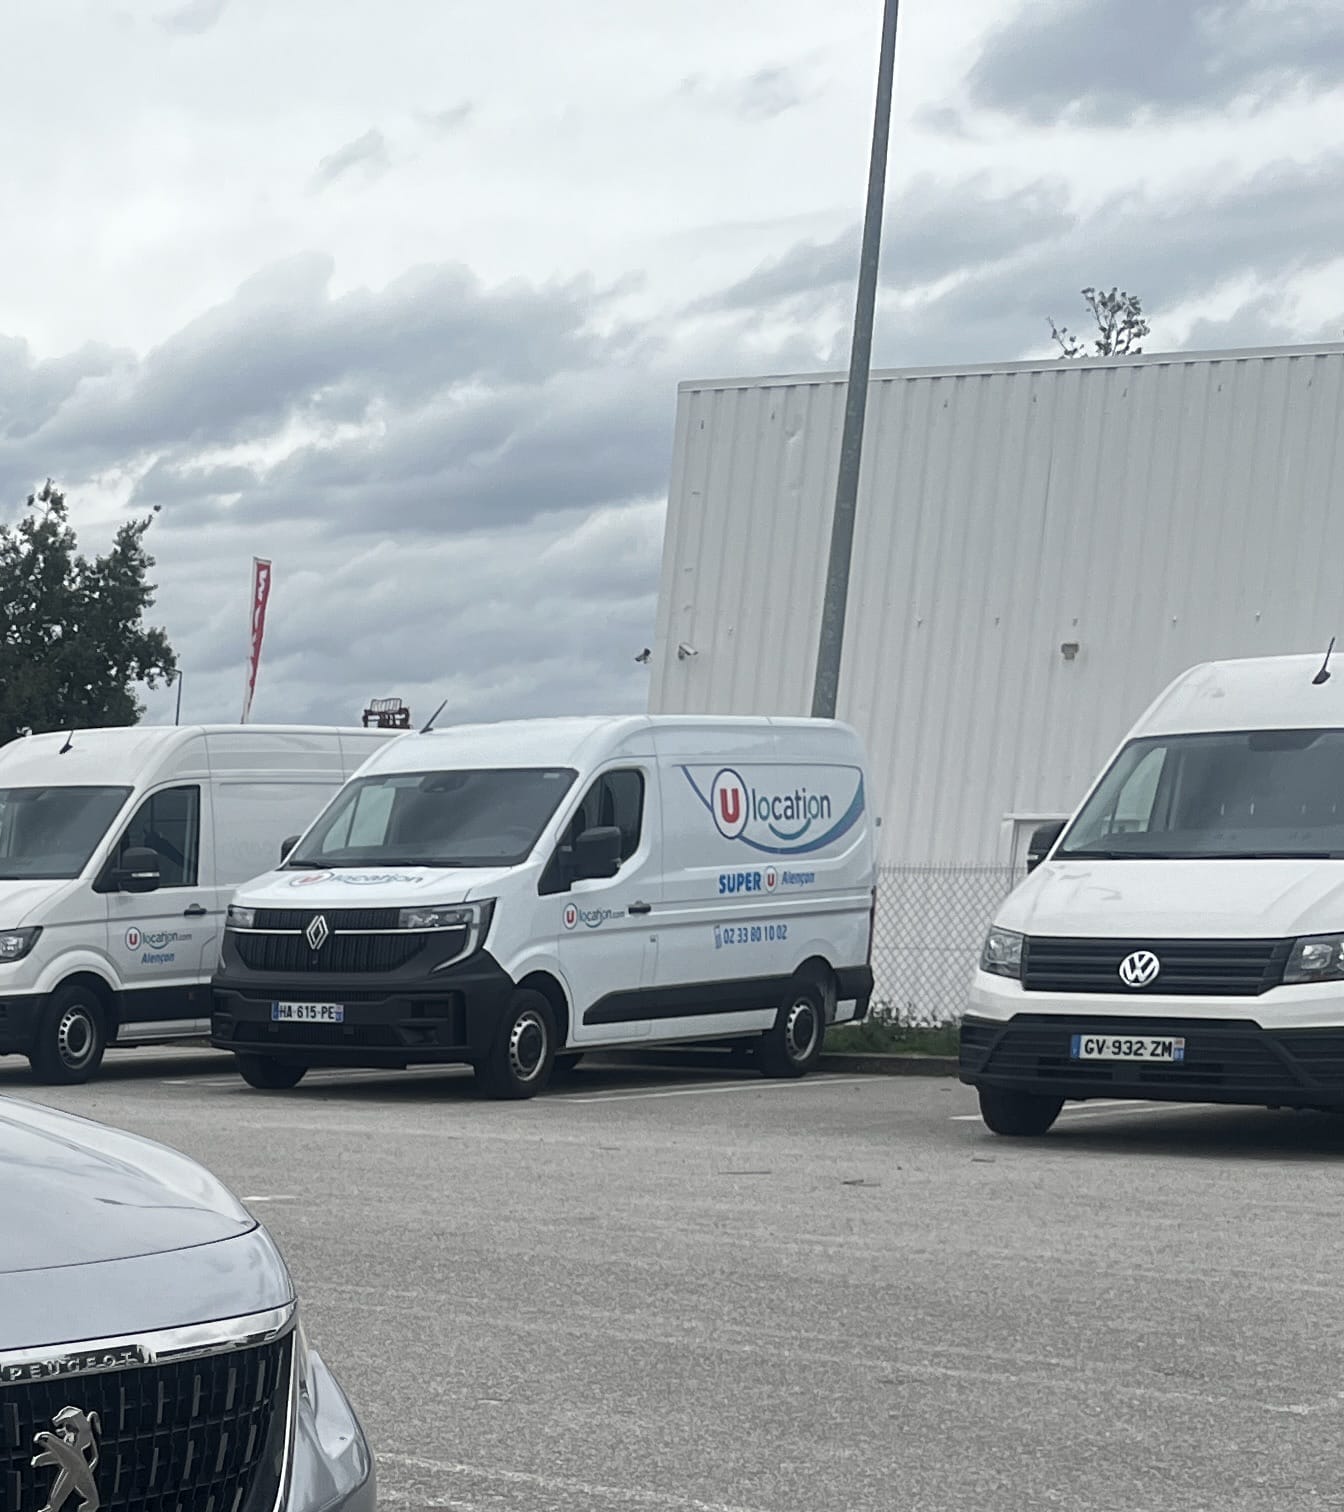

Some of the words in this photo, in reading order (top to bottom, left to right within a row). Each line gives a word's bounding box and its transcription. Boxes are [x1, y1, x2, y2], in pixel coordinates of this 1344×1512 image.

[720, 788, 740, 823] U
[752, 787, 832, 821] location
[719, 872, 761, 894] SUPER
[767, 873, 775, 887] U
[566, 910, 575, 924] U
[129, 933, 138, 945] U
[723, 928, 735, 944] 02
[737, 927, 749, 943] 33
[764, 925, 775, 941] 10
[10, 1351, 132, 1381] PEUGEOT
